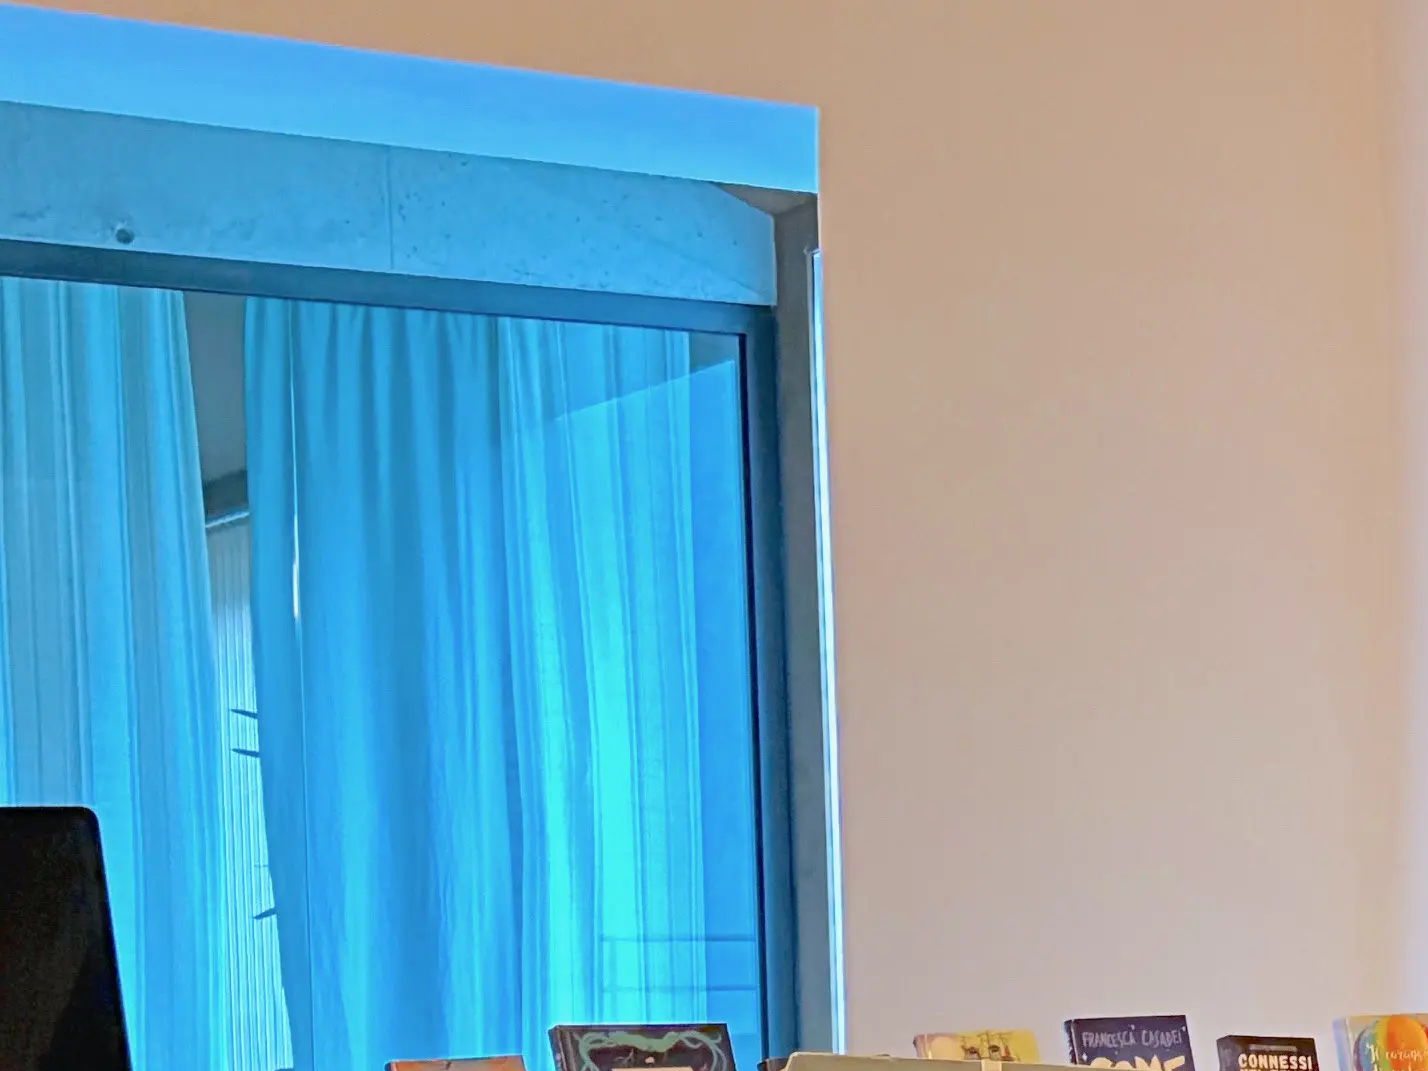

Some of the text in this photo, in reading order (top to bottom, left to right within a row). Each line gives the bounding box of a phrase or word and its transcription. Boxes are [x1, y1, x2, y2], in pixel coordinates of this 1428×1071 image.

[1082, 1028, 1184, 1049] FRANCESCA CASADEI
[1238, 1053, 1313, 1070] CONNESSI
